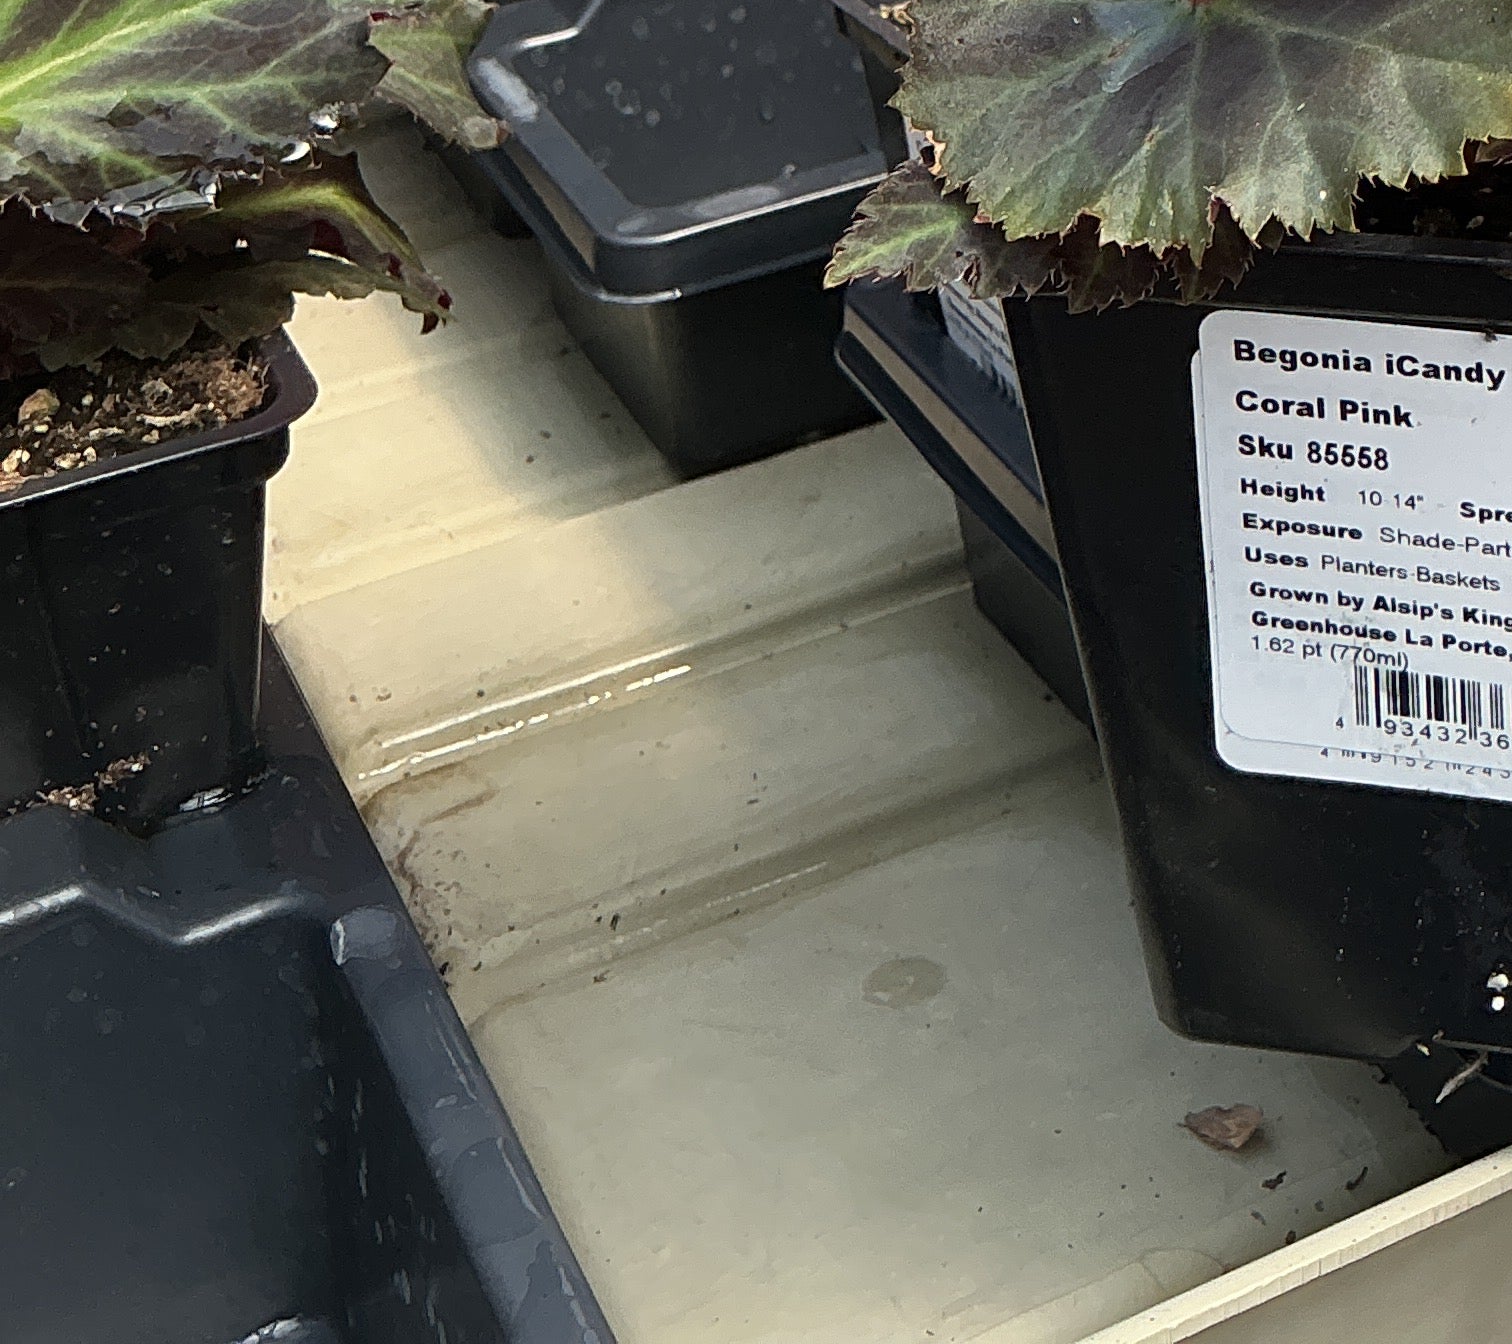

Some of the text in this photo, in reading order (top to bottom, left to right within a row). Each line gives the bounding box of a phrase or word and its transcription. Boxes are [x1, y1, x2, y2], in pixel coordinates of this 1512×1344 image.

[1234, 339, 1505, 391] Begonia iCandy
[1235, 390, 1414, 428] Coral Pink
[1238, 434, 1389, 470] Sku 85558
[1240, 478, 1326, 502] Height
[1242, 512, 1363, 539] Exposure
[1379, 526, 1511, 558] Shade-Part
[1244, 546, 1309, 568] Uses
[1249, 582, 1329, 604] Grown
[1337, 591, 1364, 611] by
[1373, 595, 1454, 621] Alsip's
[1251, 611, 1397, 642] Greenhouse
[1405, 629, 1433, 647] La
[1251, 635, 1409, 672] 1.62 pt (770ml)
[1335, 716, 1344, 729] 4
[1383, 719, 1467, 745] 93432
